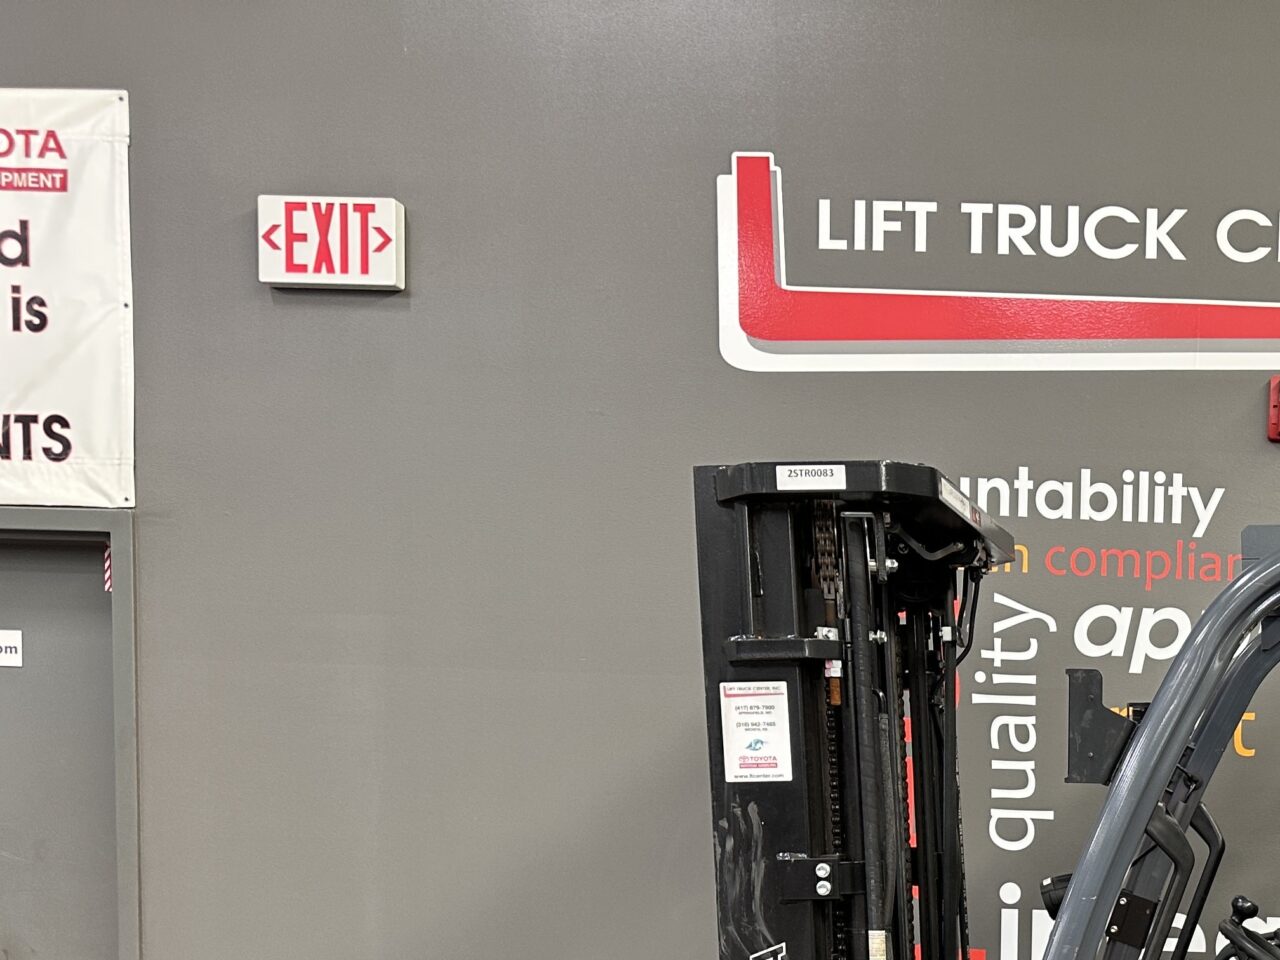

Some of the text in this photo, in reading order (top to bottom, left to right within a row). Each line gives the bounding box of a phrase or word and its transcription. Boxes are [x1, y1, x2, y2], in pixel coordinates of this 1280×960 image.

[284, 201, 376, 275] EXIT
[818, 198, 938, 253] LIFT
[960, 202, 1188, 261] TRUCK
[11, 285, 48, 333] is
[787, 468, 834, 478] 2STR0083
[960, 466, 1225, 538] ntability
[971, 592, 1058, 852] quality
